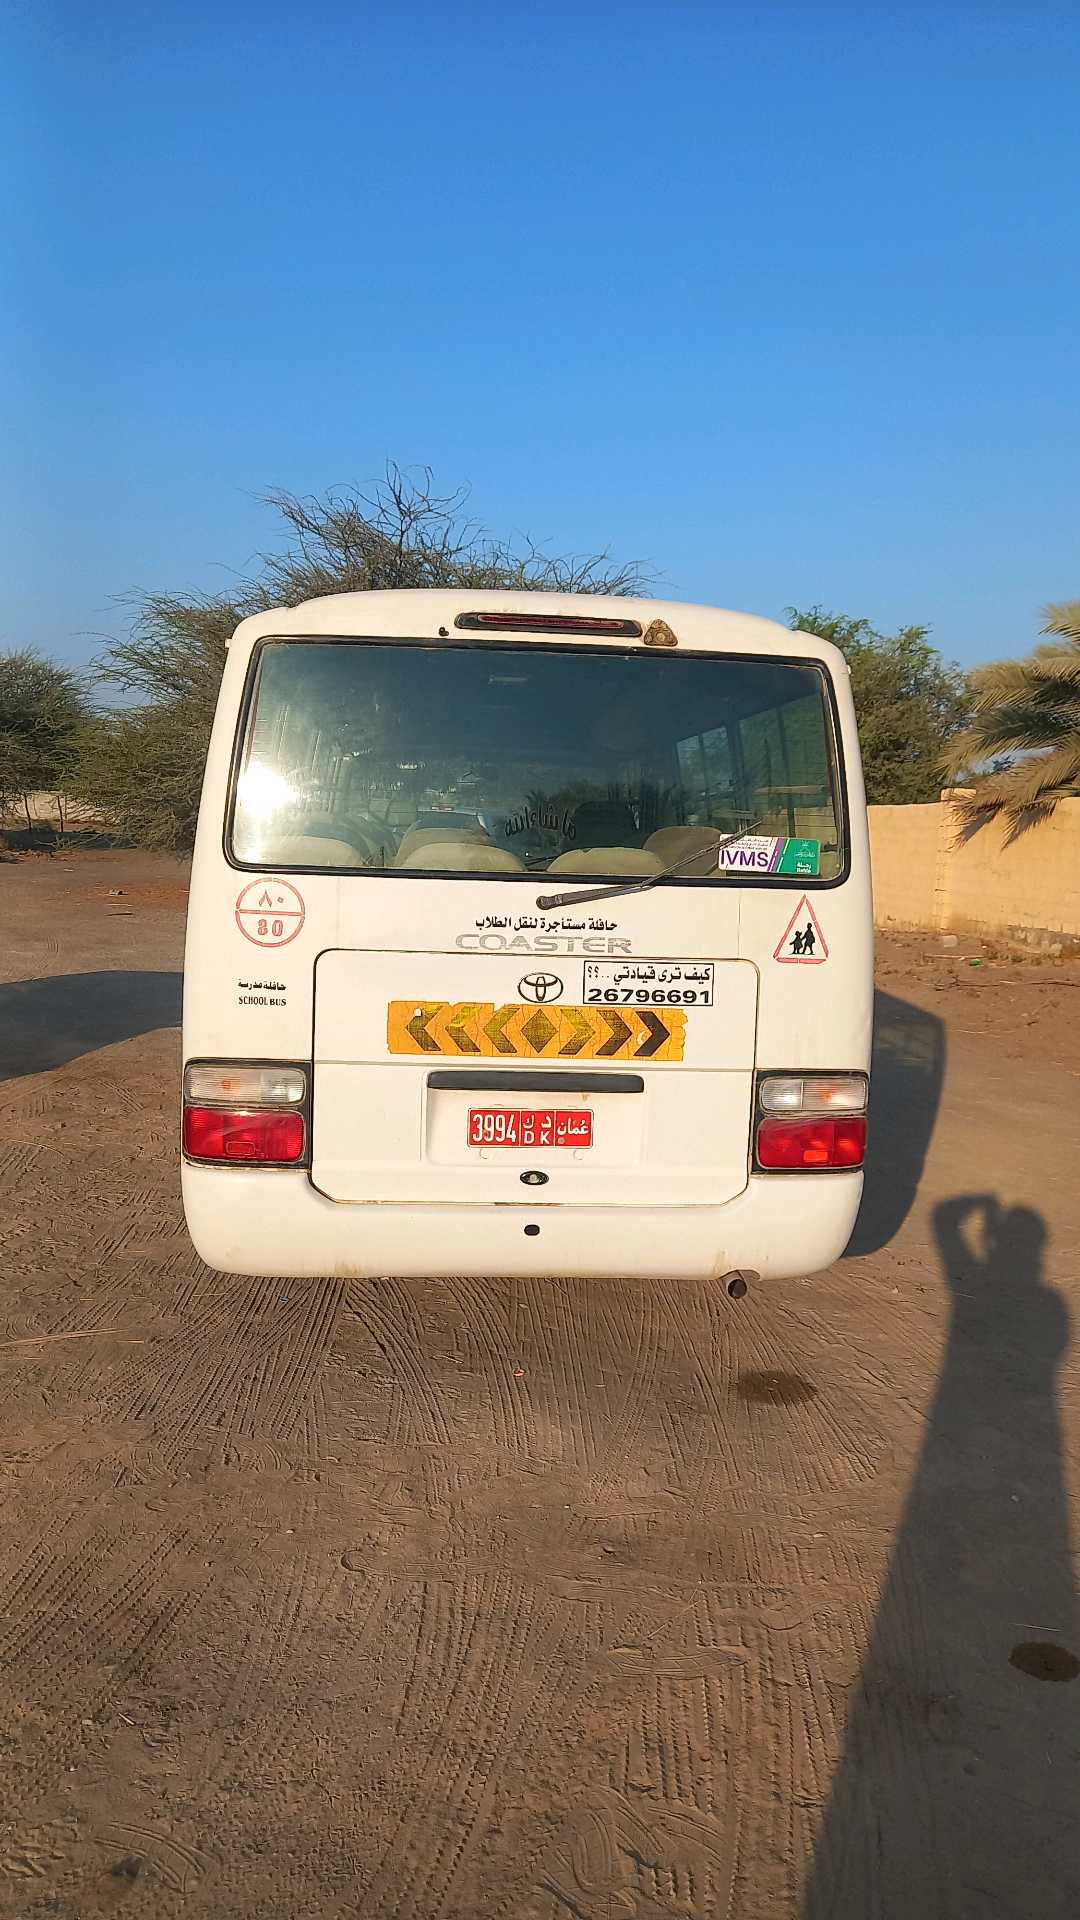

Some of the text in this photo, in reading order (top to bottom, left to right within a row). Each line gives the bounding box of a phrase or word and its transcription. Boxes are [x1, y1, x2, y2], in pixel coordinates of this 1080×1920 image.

[720, 849, 769, 867] IVMS
[257, 918, 284, 937] 80
[475, 915, 618, 933] حافلة مستأجرة لنقل الطلاب
[455, 933, 633, 954] COASTER
[613, 965, 656, 986] قيادتي
[658, 966, 682, 984] ترى
[684, 966, 711, 985] كيف
[238, 995, 287, 1006] SCHOOL BUS
[587, 988, 710, 1004] 26796691
[472, 1113, 517, 1143] 3994
